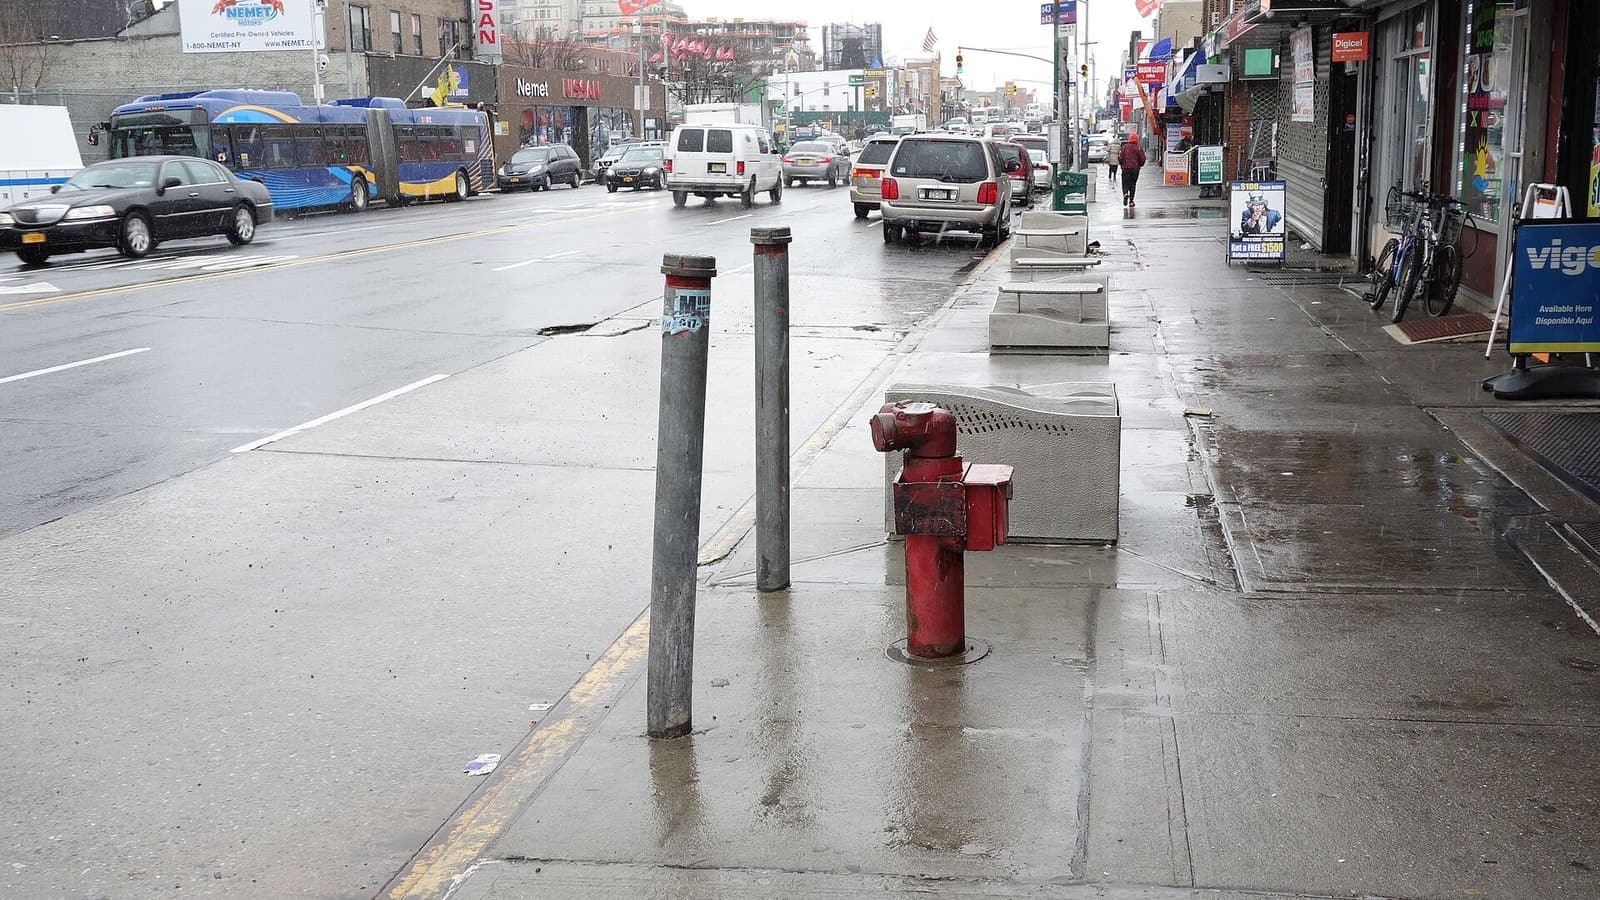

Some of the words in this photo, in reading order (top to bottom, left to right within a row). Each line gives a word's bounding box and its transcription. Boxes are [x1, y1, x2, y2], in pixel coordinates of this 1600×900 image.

[226, 7, 272, 18] NEMET
[1335, 39, 1363, 48] Digicel
[516, 78, 549, 97] Nemet
[562, 78, 602, 99] NISSAN
[1248, 243, 1261, 252] FREE
[1262, 243, 1283, 252] $1500
[1539, 305, 1573, 313] Available
[1535, 317, 1574, 326] Disponible
